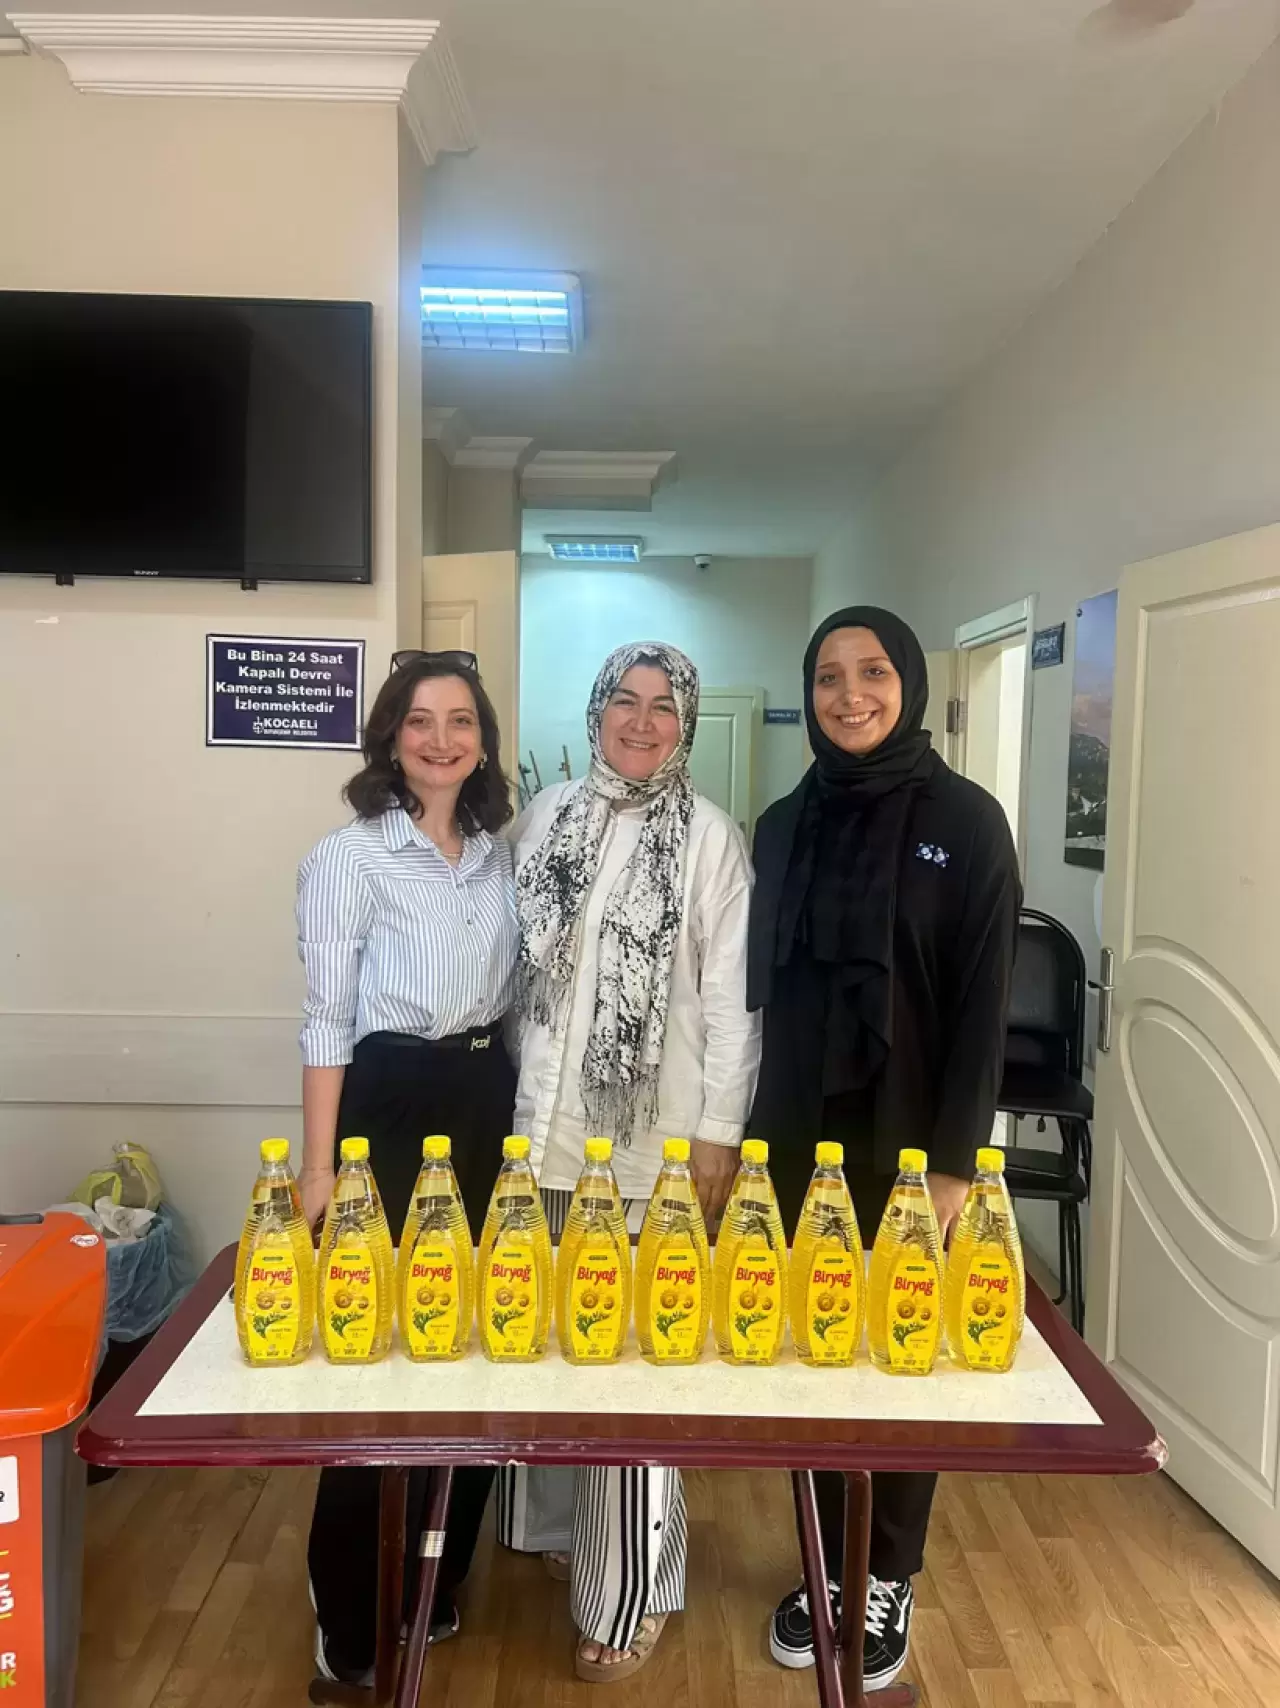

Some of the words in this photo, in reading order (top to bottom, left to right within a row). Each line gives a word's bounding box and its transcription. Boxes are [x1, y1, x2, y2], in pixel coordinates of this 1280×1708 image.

[227, 649, 246, 660] Bu
[251, 650, 283, 662] Bina
[288, 651, 306, 662] 24
[310, 653, 343, 664] Saat
[238, 666, 284, 679] Kapalı
[290, 668, 331, 680] Devre
[216, 682, 272, 694] Kamera
[277, 684, 331, 696] Sistemi
[336, 684, 354, 697] İle
[235, 696, 335, 713] İzlenmektedir
[251, 1267, 294, 1285] Biryağ
[330, 1266, 370, 1284] Biryağ
[412, 1264, 452, 1282] Biryağ
[492, 1263, 531, 1282] Biryağ
[577, 1266, 617, 1285] Biryağ
[657, 1266, 696, 1285] Biryağ
[735, 1267, 775, 1285] Biryağ
[813, 1270, 852, 1288] Biryağ
[894, 1276, 935, 1296] Biryağ
[968, 1273, 1008, 1293] Biryağ
